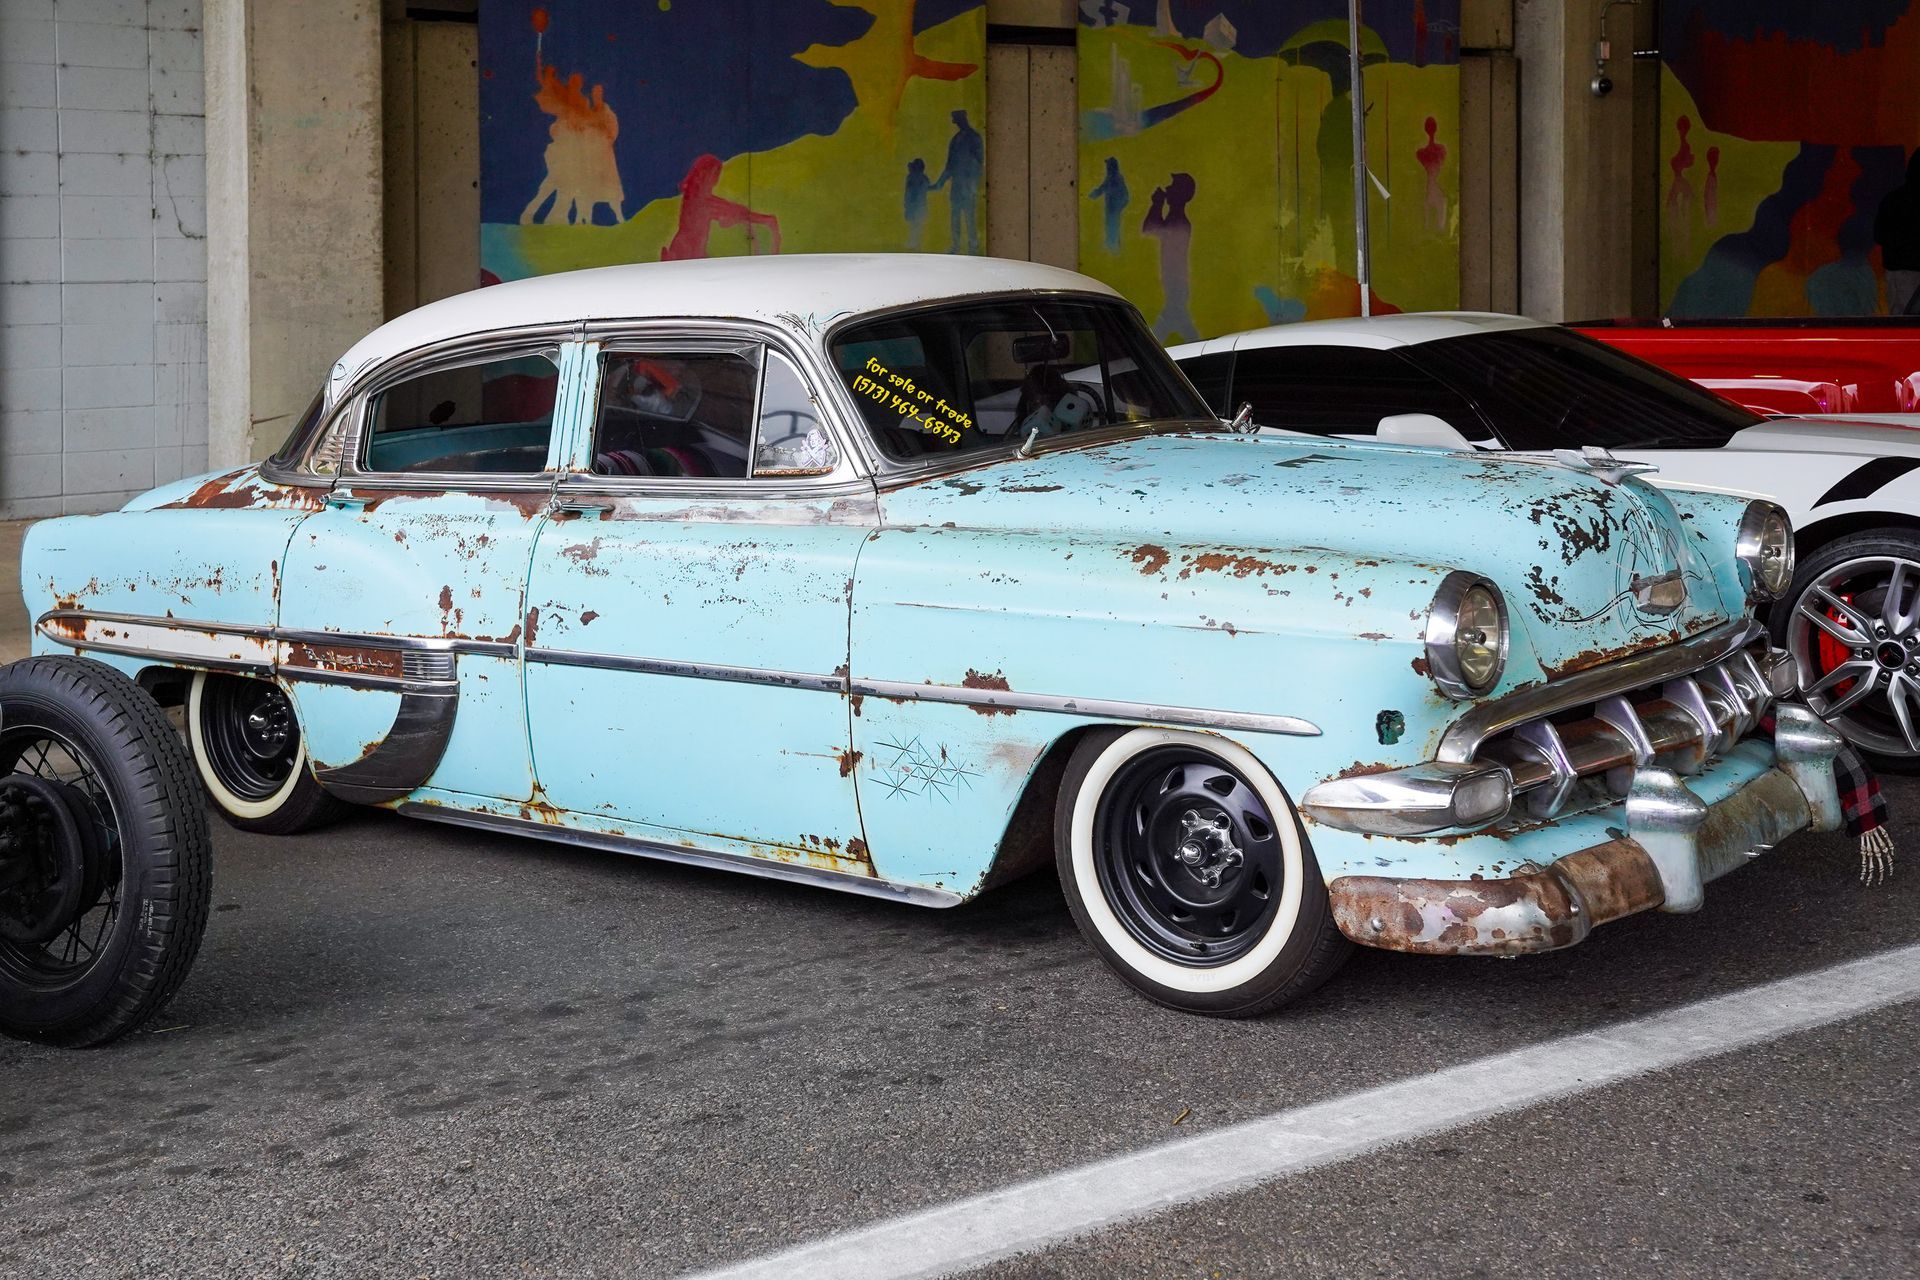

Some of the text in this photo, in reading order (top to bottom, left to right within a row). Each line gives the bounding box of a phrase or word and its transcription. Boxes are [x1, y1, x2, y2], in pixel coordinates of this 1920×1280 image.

[852, 374, 962, 444] (513) 464-6843
[865, 356, 972, 429] for sale or trade
